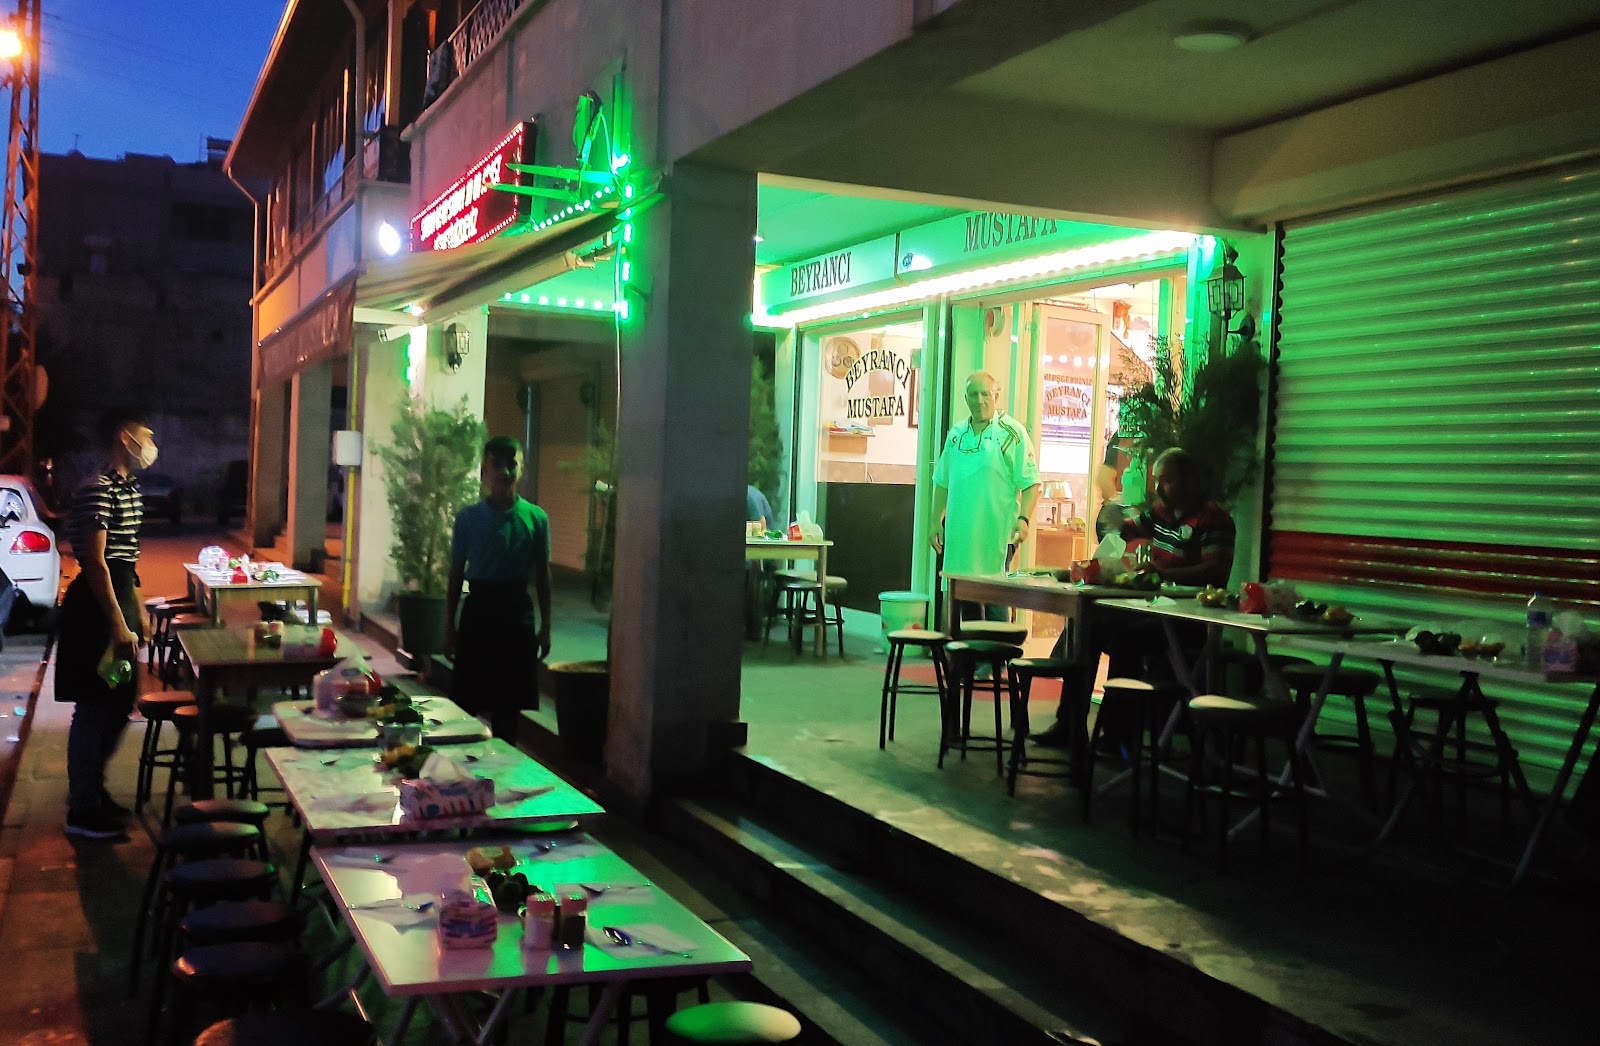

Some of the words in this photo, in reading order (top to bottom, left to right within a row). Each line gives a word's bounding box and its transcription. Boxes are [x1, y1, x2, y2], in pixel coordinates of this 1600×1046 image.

[789, 252, 852, 297] BEYRANCI
[845, 350, 912, 393] BEYRANCI
[847, 395, 904, 419] MUSTAFA
[1046, 385, 1091, 407] BEYRANCI
[1047, 405, 1087, 419] MUSTAFA
